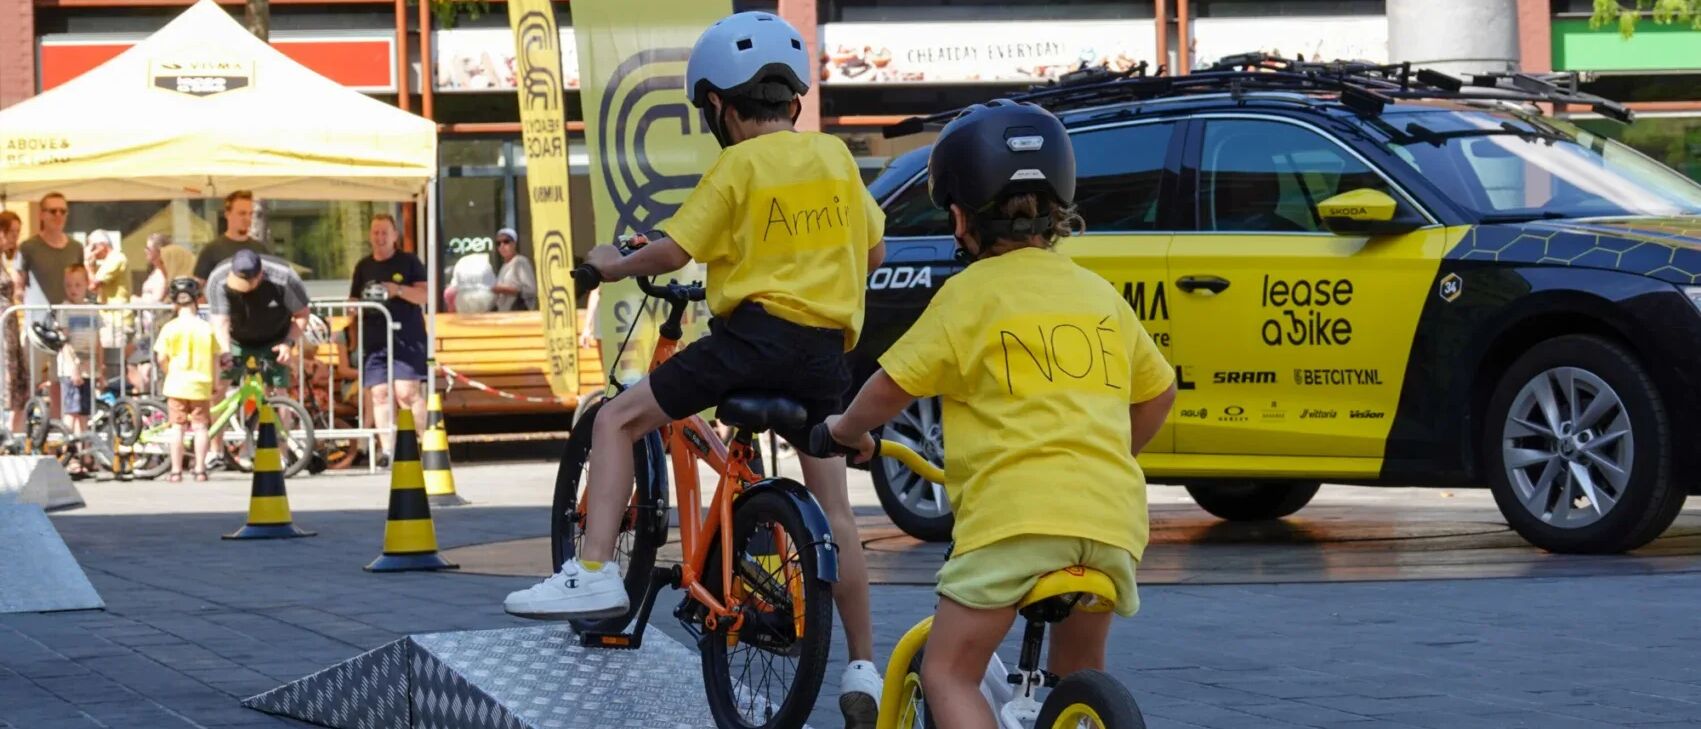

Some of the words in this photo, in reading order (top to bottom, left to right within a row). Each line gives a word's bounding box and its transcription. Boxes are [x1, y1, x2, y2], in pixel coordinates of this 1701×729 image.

[449, 236, 494, 255] open
[867, 266, 932, 290] ODA
[1262, 274, 1353, 307] lease
[1001, 315, 1121, 394] NOÉ
[1213, 371, 1277, 384] SRAM
[1304, 369, 1383, 385] BETCITY.NL
